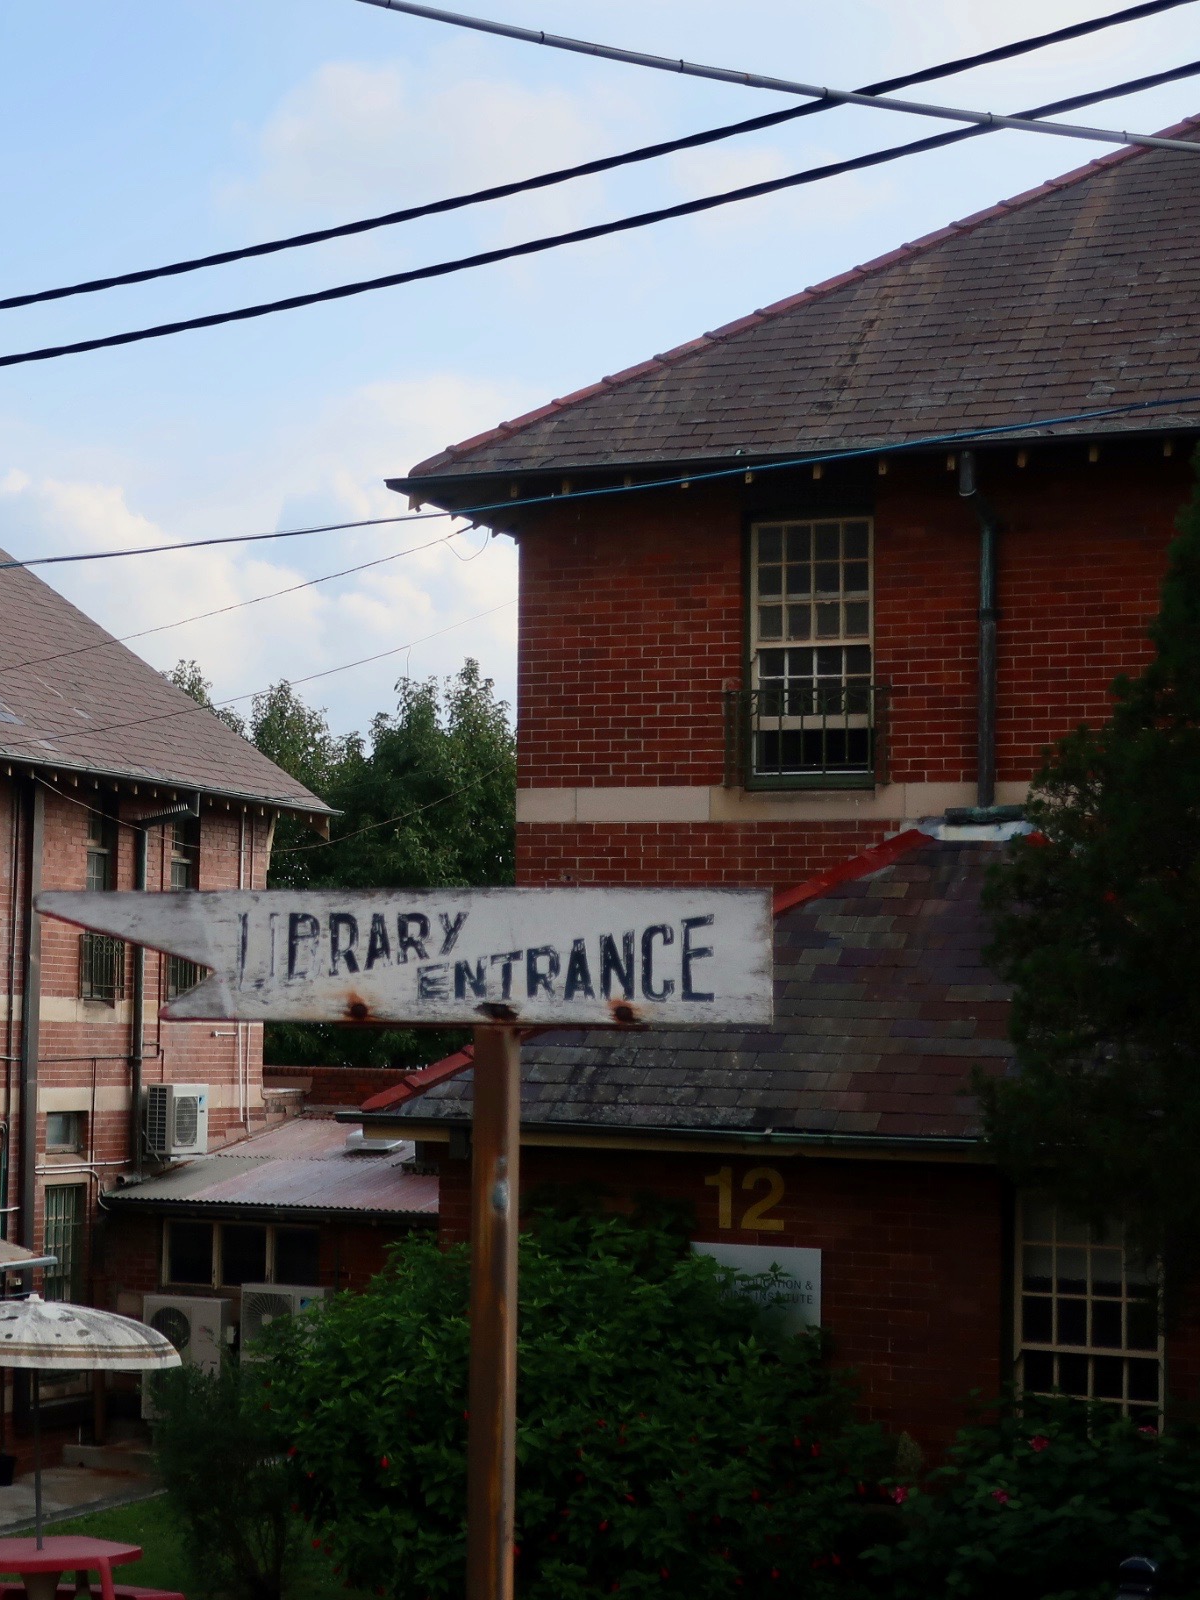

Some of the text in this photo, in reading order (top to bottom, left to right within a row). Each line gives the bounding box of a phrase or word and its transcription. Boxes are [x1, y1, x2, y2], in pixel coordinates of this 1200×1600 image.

[237, 911, 469, 988] LIBRARY
[416, 913, 715, 1003] ENTRANCE
[704, 1166, 785, 1231] 12
[805, 1280, 813, 1291] &
